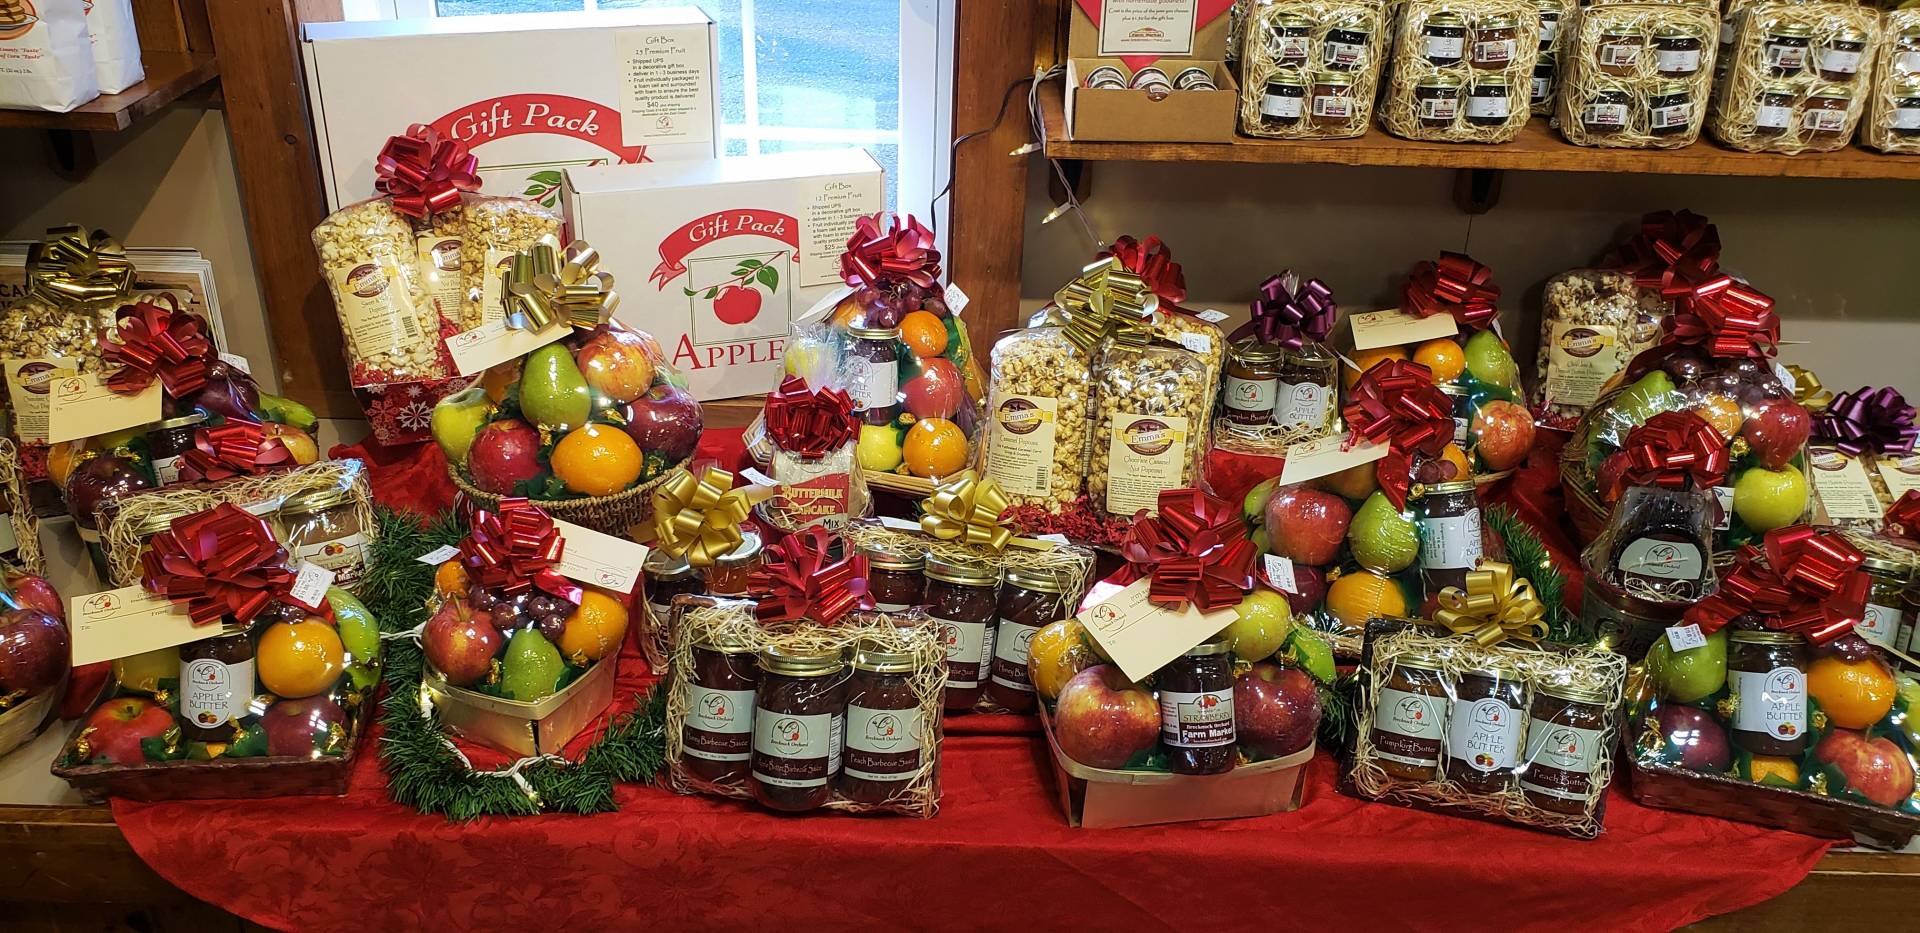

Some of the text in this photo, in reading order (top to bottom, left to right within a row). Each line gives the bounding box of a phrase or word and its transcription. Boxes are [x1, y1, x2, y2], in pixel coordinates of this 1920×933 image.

[660, 36, 674, 44] Box
[451, 102, 600, 142] Gift Pack
[825, 182, 852, 191] Gift Box
[689, 214, 785, 242] Gift Pack
[1005, 412, 1035, 422] Emma's
[1132, 432, 1166, 443] Emma's
[782, 485, 844, 500] BUTTERMILK
[823, 519, 840, 529] MIX
[192, 692, 224, 702] APPLE
[190, 700, 229, 710] BUTTER
[1771, 702, 1801, 711] APPLE
[1766, 712, 1804, 721] BUTTER
[1182, 726, 1233, 739] Farm Market
[729, 738, 749, 748] Sauce
[1380, 736, 1436, 753] Pumpkin Butter
[1467, 740, 1505, 754] BUTTER
[850, 753, 916, 767] Peach Barbecue Sauce
[1534, 768, 1559, 782] Peach
